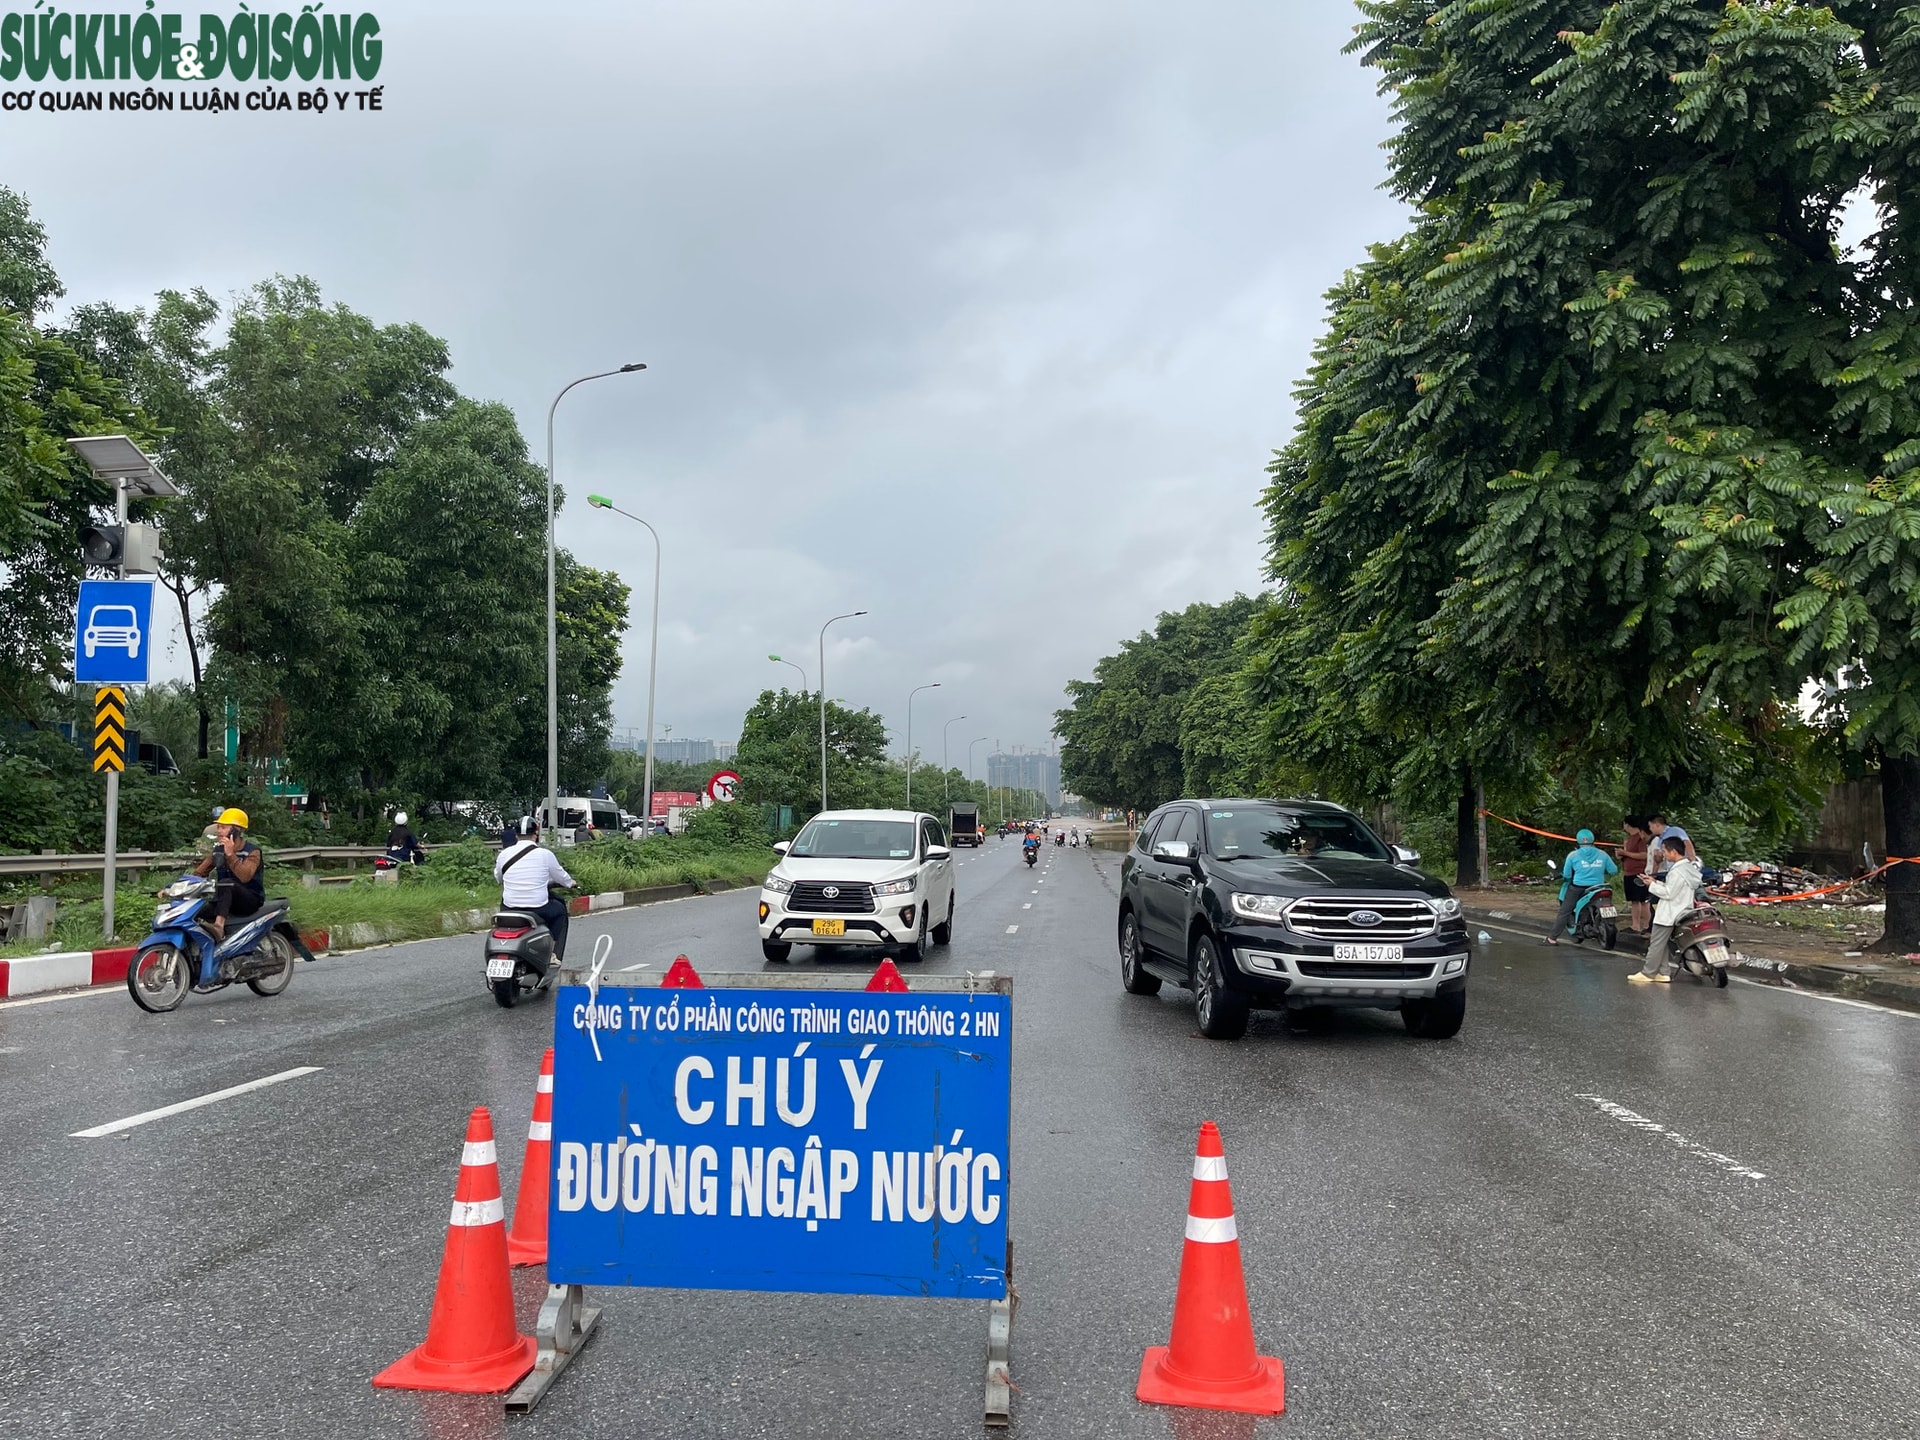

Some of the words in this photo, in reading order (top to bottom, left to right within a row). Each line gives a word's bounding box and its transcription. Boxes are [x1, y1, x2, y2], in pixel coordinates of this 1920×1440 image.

[1336, 946, 1402, 960] 35A-157.08
[629, 1005, 651, 1030] TY
[655, 994, 680, 1031] CỔ
[684, 995, 732, 1032] PHẦN
[736, 1001, 785, 1033] CÔNG
[790, 1002, 841, 1033] TRÌNH
[847, 1008, 890, 1035] GIAO
[895, 1004, 955, 1036] THÔNG
[959, 1012, 970, 1036] 2
[975, 1012, 999, 1037] HN
[675, 1041, 818, 1128] CHÚ
[839, 1043, 884, 1130] Ý
[557, 1123, 718, 1216] ĐƯỜNG
[730, 1135, 860, 1232] NGẬP
[871, 1128, 1001, 1225] NƯỚC
